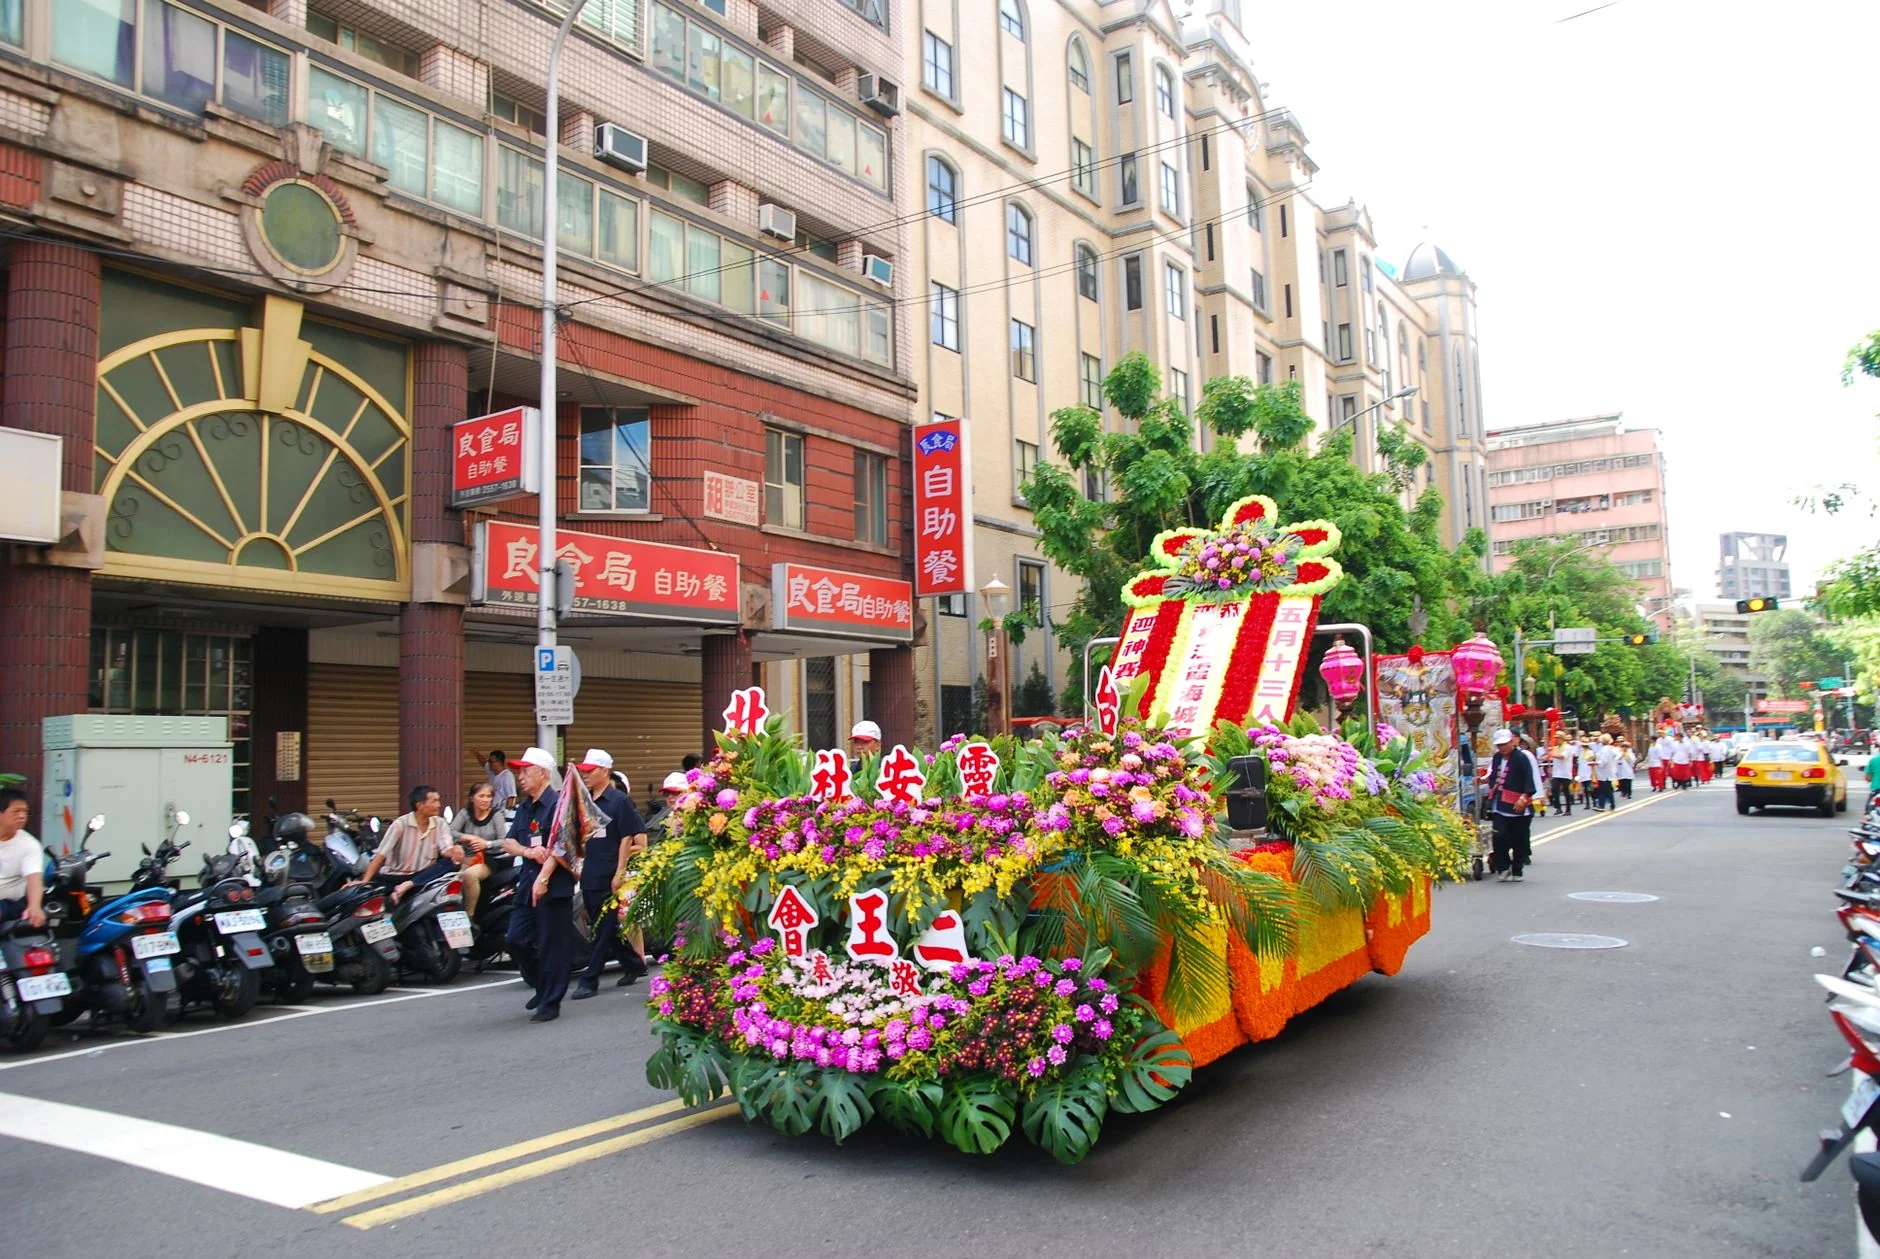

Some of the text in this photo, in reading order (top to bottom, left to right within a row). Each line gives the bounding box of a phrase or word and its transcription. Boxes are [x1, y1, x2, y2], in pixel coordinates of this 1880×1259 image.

[458, 422, 520, 458] 良食局
[919, 432, 956, 456] 良食局
[468, 455, 508, 479] 自助餐
[922, 464, 958, 586] 自助餐
[502, 536, 728, 602] 良食局 自助餐
[501, 590, 627, 612] 外送專 57-1638
[787, 573, 911, 623] 良食局 自助餐
[541, 652, 553, 669] P
